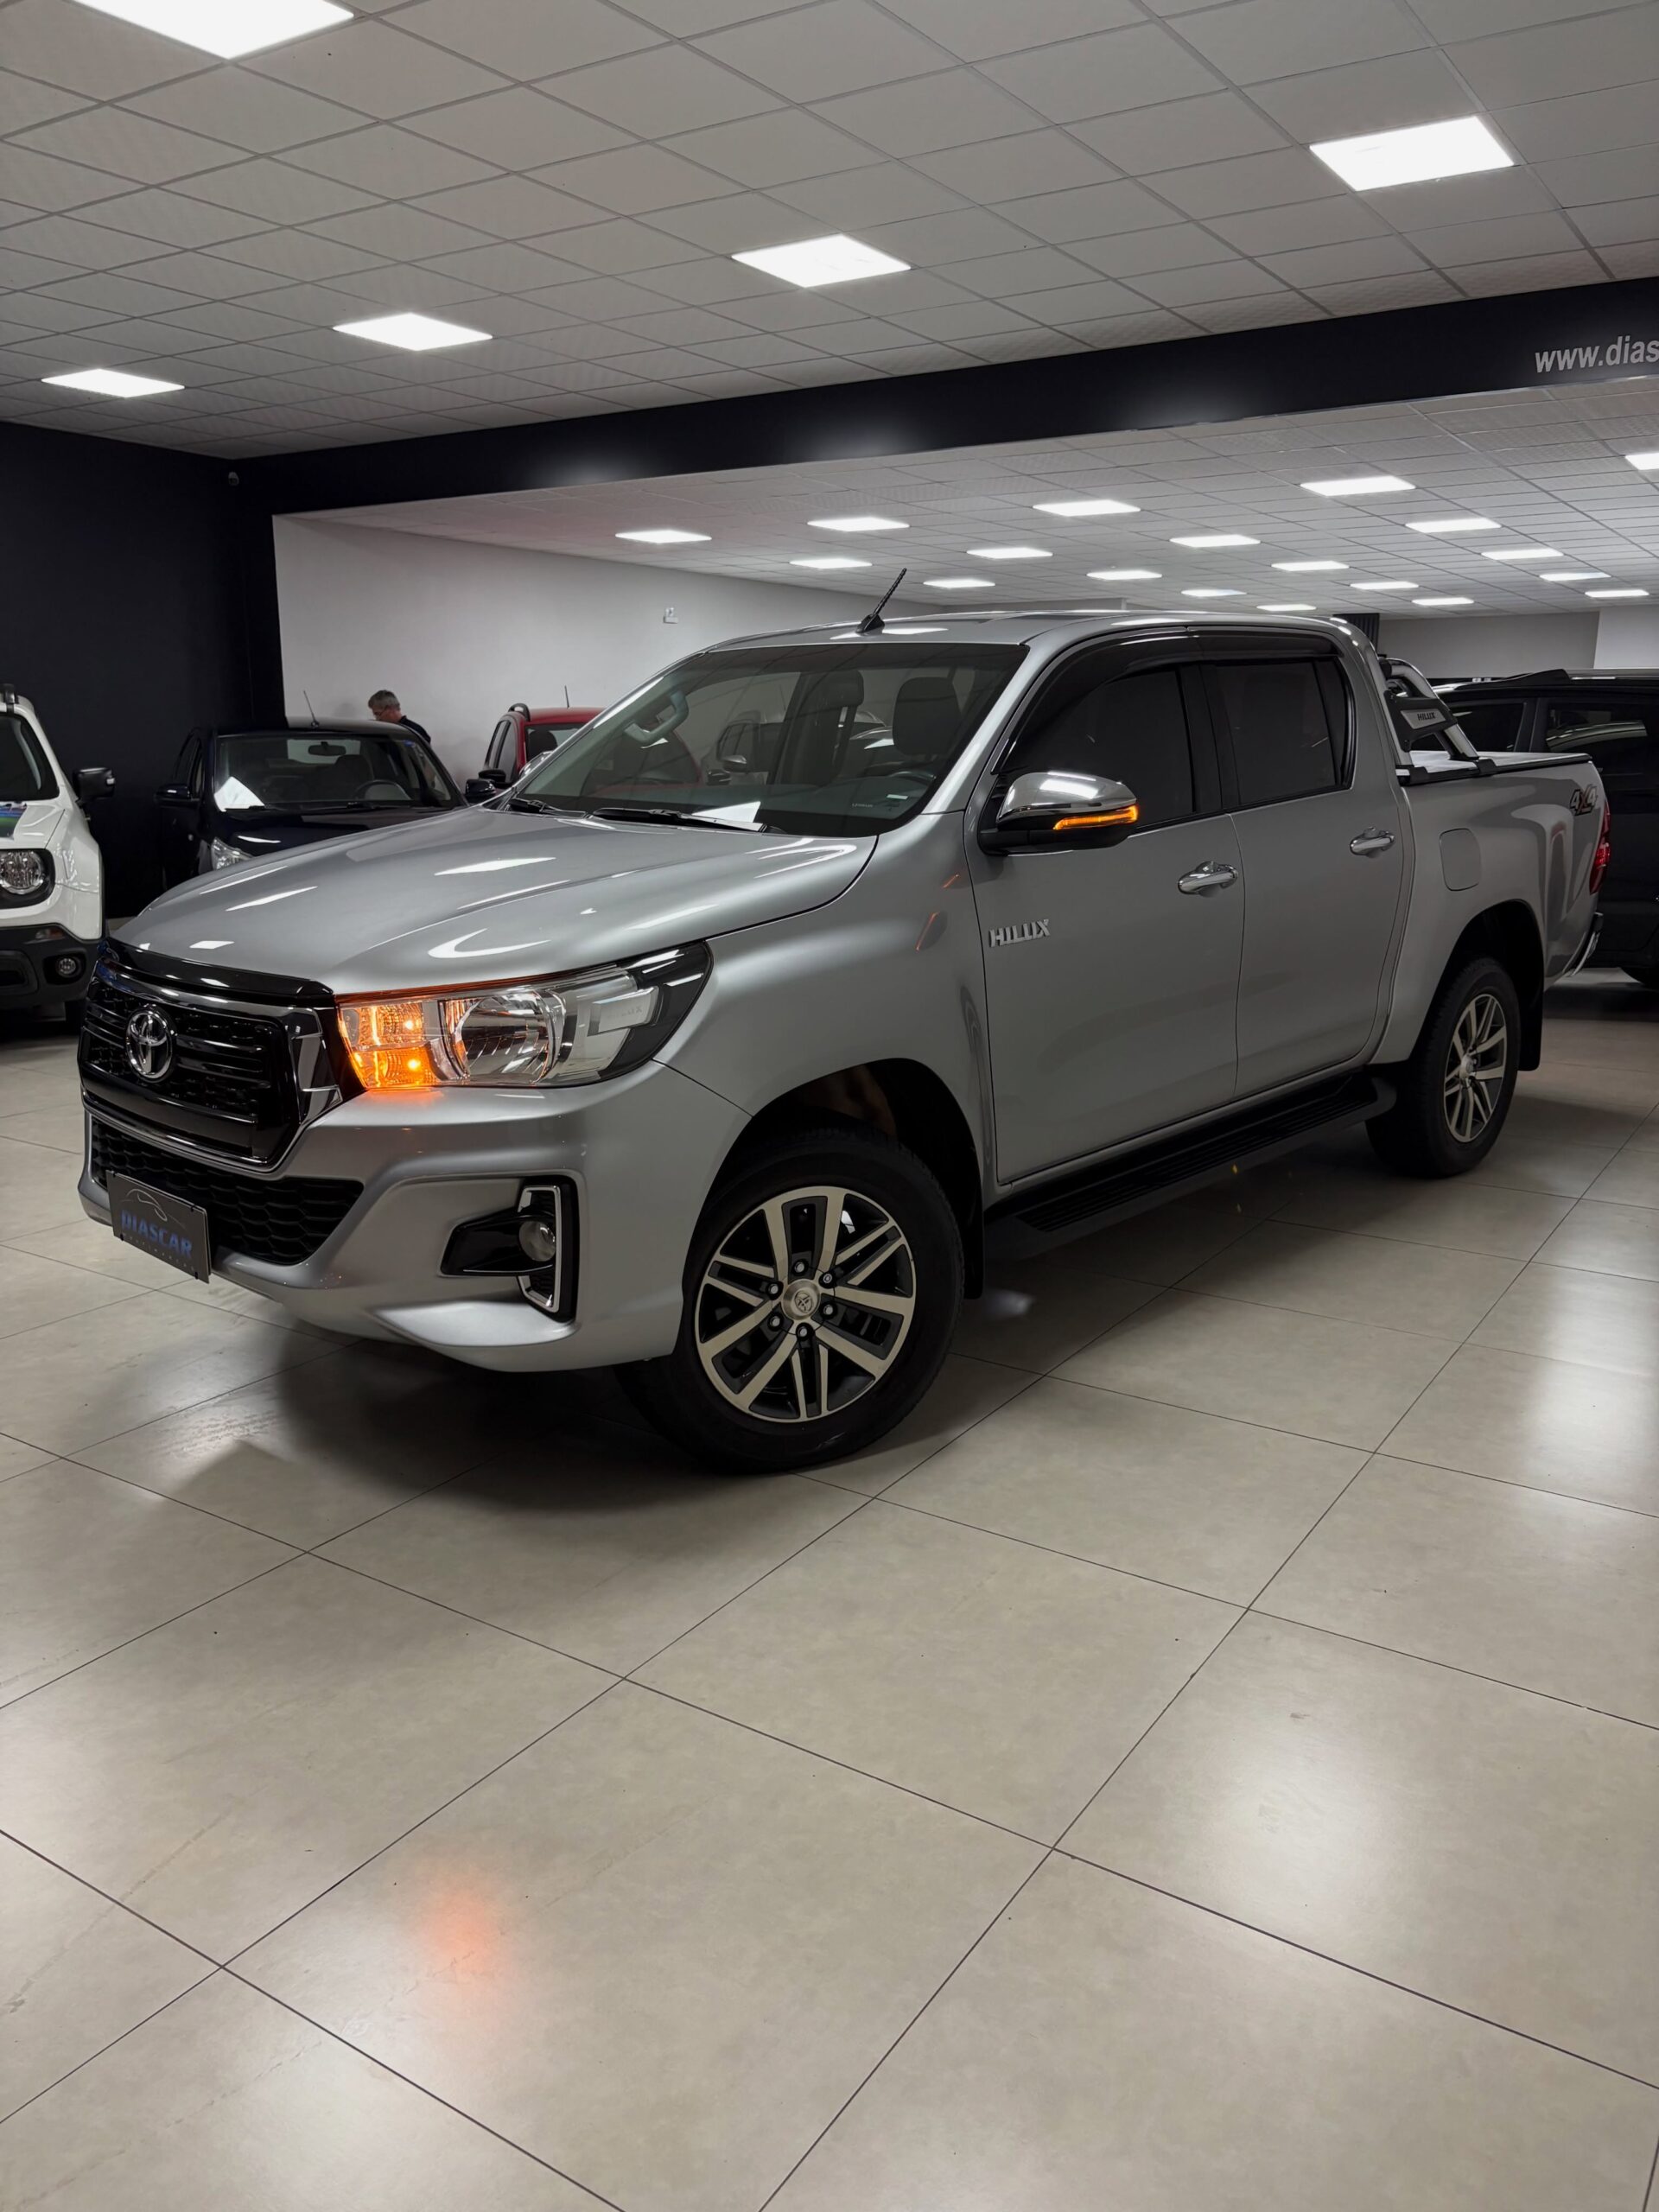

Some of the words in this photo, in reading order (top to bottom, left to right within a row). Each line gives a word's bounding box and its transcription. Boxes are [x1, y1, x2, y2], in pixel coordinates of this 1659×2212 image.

[1535, 335, 1659, 373] www.dias
[1417, 712, 1436, 721] HILUX
[988, 918, 1051, 947] HILUX
[121, 1211, 193, 1258] DIASCAR
